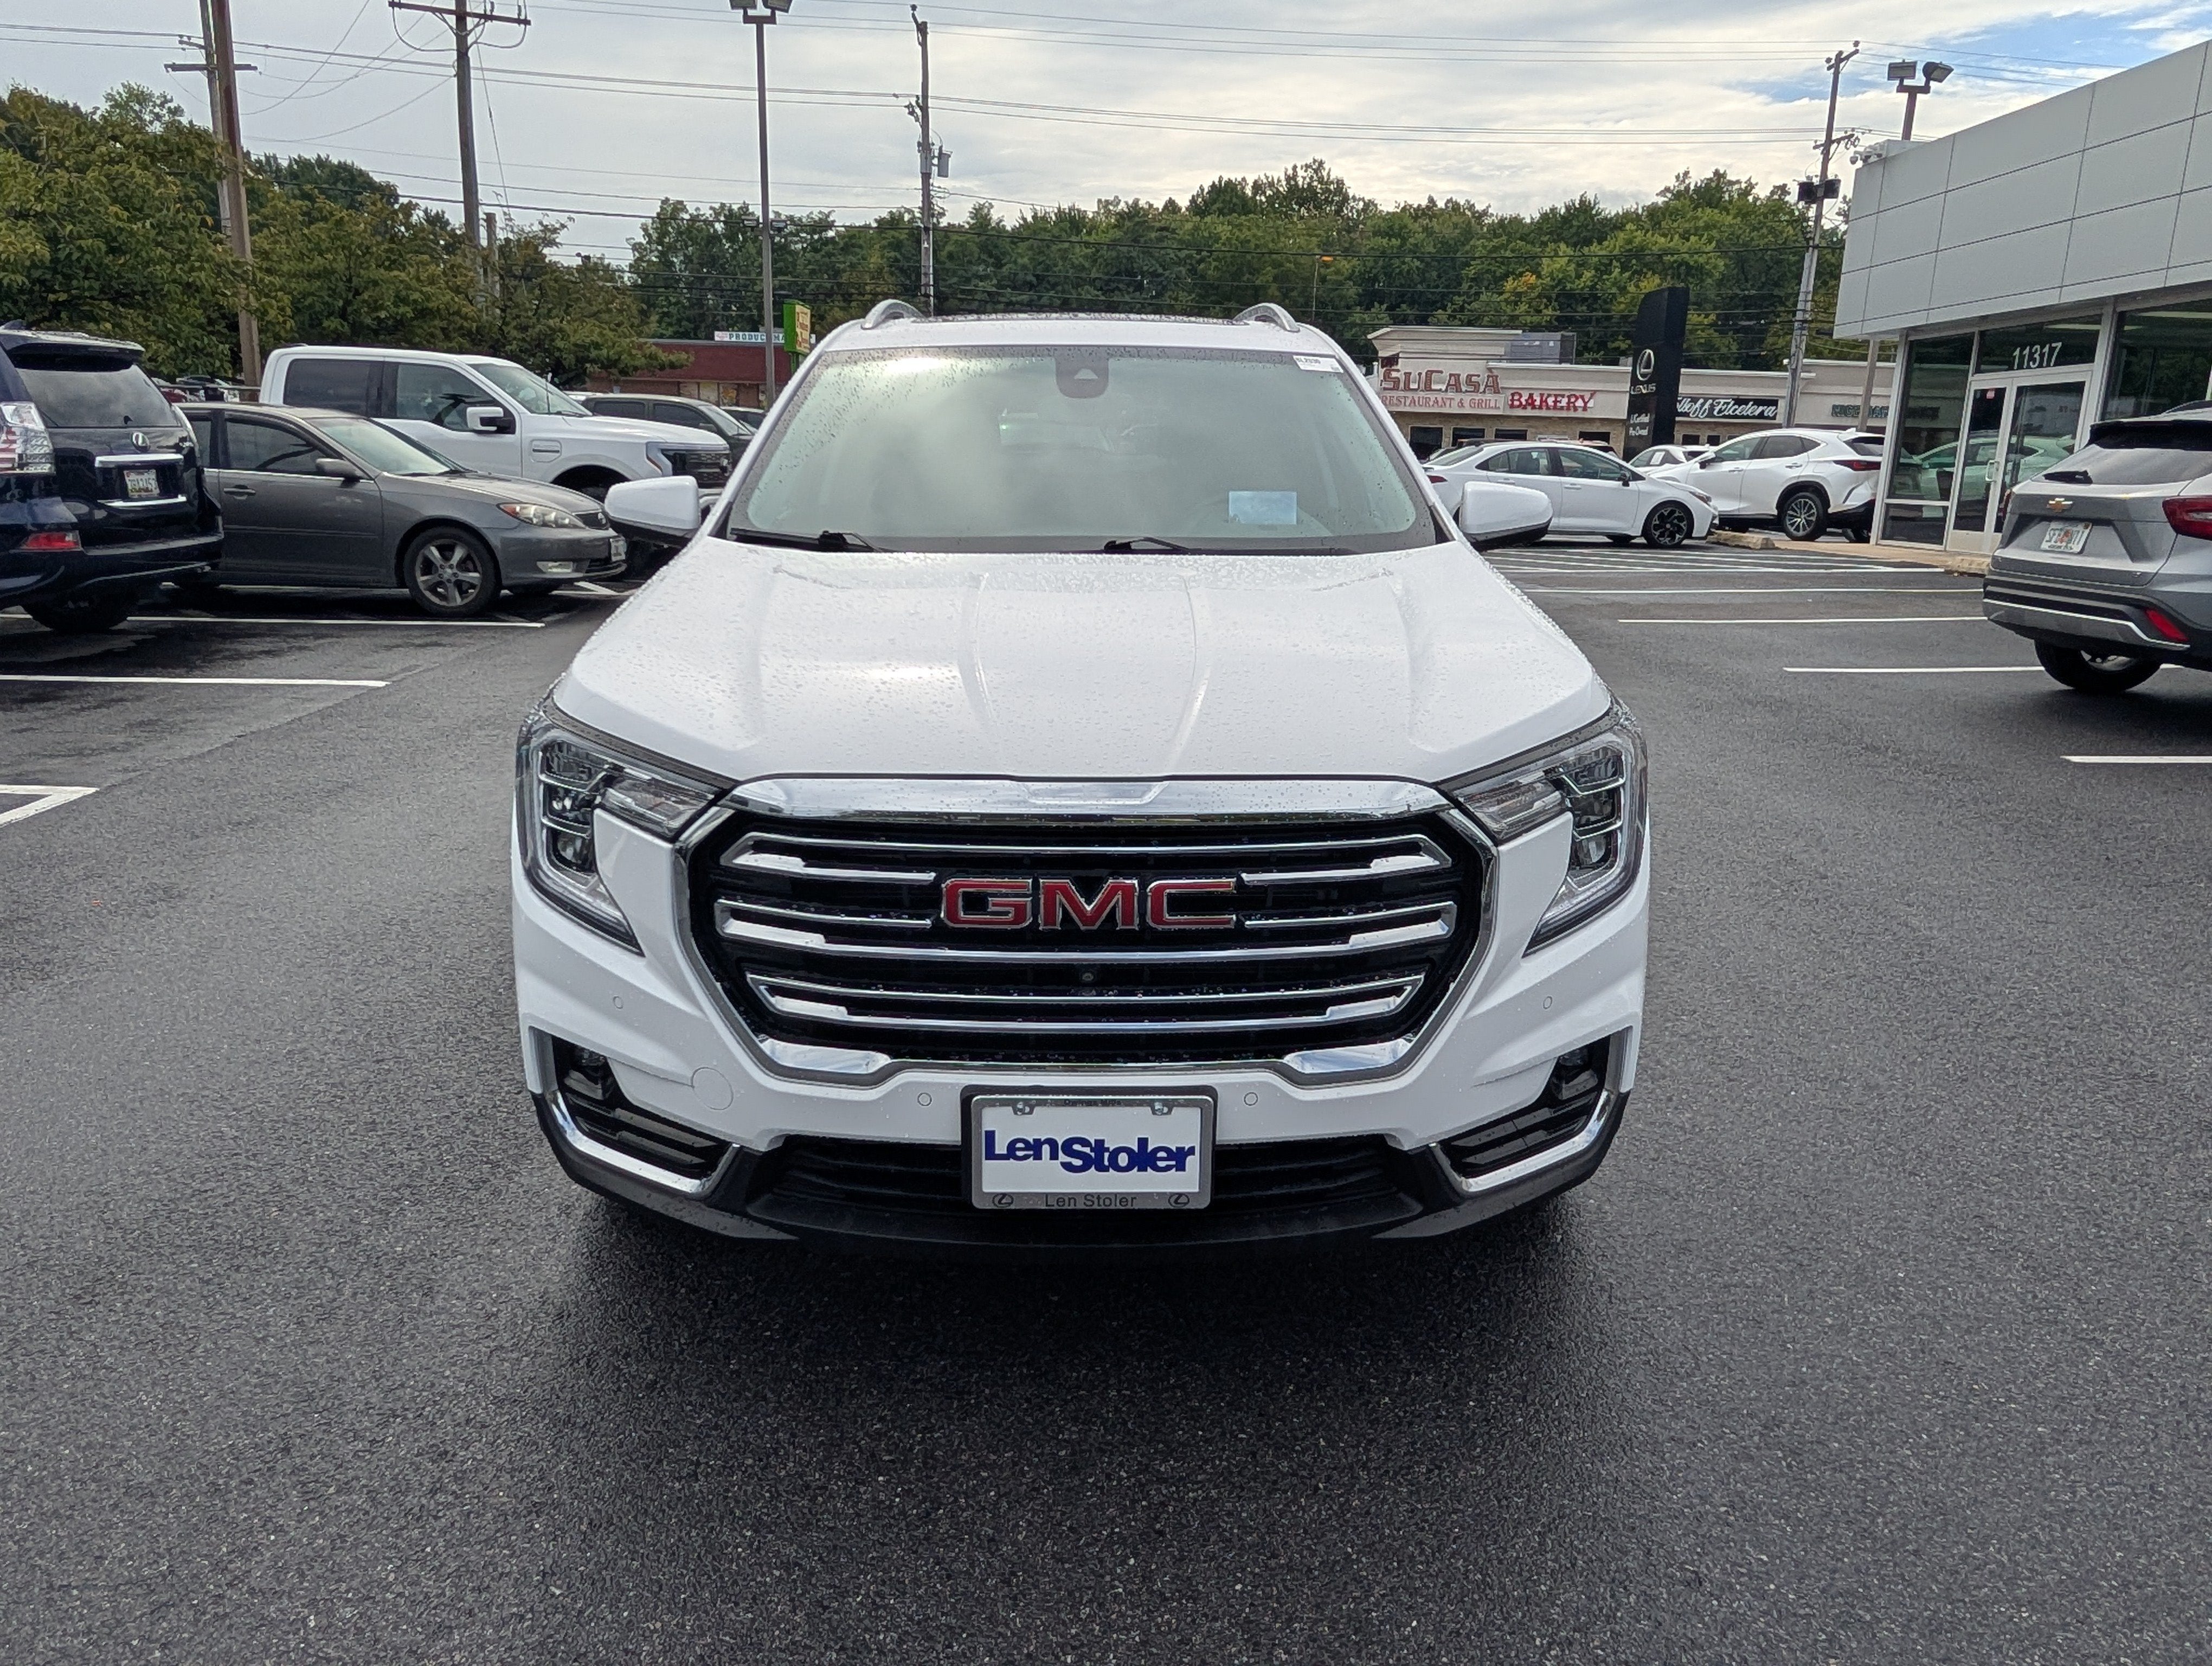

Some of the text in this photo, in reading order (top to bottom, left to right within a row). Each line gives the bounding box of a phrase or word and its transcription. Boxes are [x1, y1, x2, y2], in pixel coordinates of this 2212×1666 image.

[729, 333, 766, 341] PRODUC
[2012, 342, 2062, 370] 11317
[1630, 383, 1657, 395] LEXUS
[1381, 395, 1501, 410] RESTAURANT & GRILL
[1508, 390, 1597, 412] BAKERY
[941, 877, 1236, 930] GMC
[1045, 1193, 1137, 1208] Len Stoler
